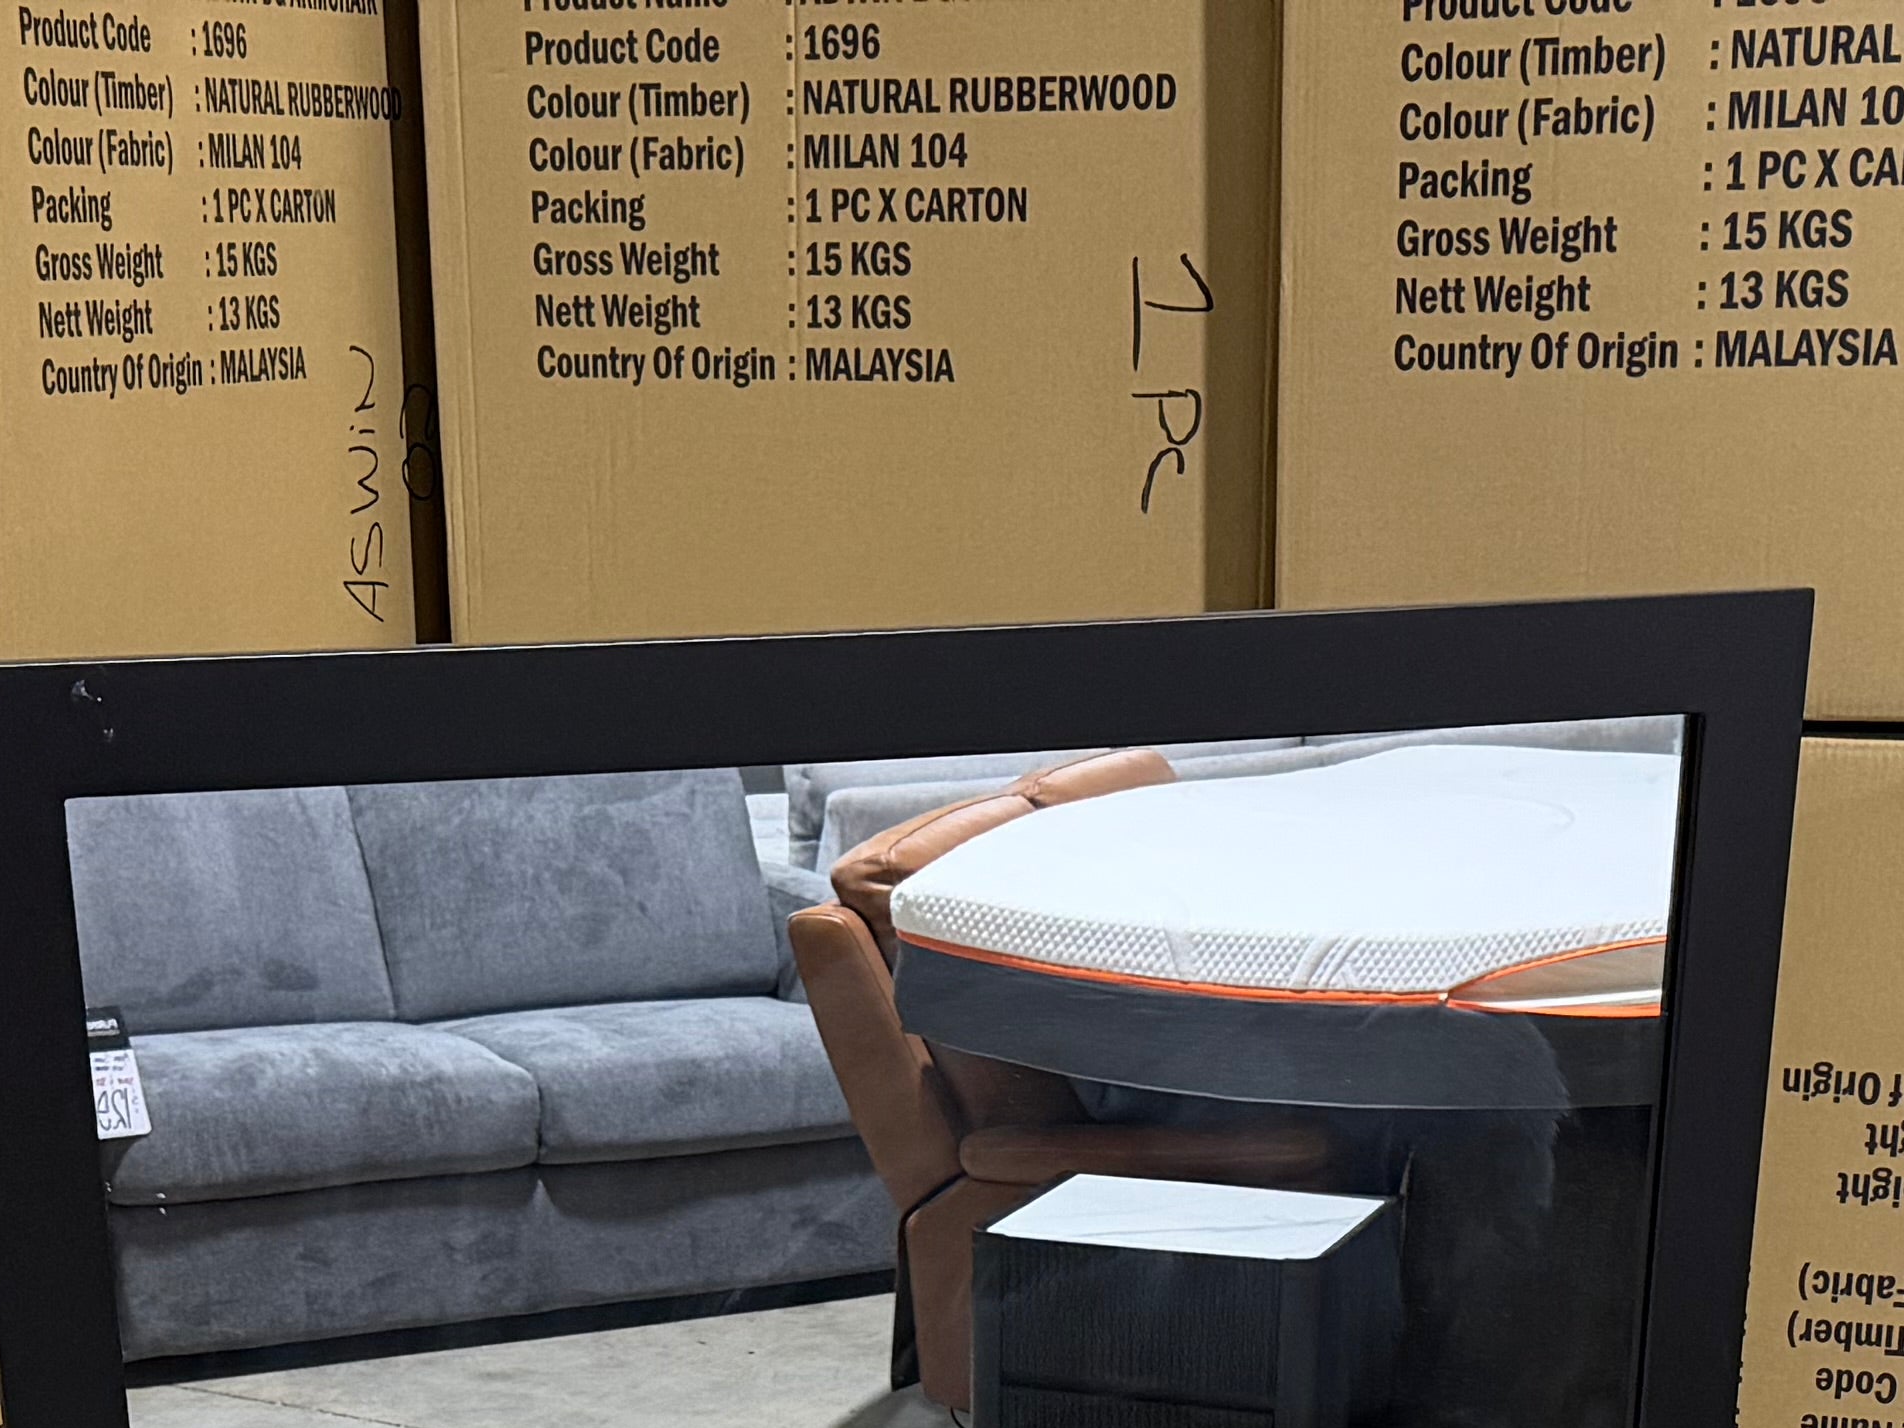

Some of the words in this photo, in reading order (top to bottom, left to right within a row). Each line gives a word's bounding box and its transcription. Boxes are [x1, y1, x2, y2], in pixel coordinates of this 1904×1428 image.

[18, 5, 100, 50] Product
[102, 11, 152, 53] Code
[525, 29, 639, 66] Product
[645, 27, 720, 64] Code
[1400, 41, 1512, 83] Colour
[1519, 32, 1666, 87] (Timber)
[23, 66, 90, 108] Colour
[94, 70, 174, 120] (Timber)
[527, 84, 622, 120] Colour
[628, 80, 750, 126] (Timber)
[949, 73, 1177, 113] RUBBERWOOD
[1399, 101, 1510, 142] Colour
[1517, 94, 1655, 146] (Fabric)
[27, 126, 94, 166] Colour
[98, 128, 174, 176] (Fabric)
[269, 134, 302, 171] 104
[531, 189, 646, 232] Packing
[831, 187, 871, 223] PC
[877, 187, 898, 223] X
[905, 186, 1027, 223] CARTON
[1397, 219, 1491, 258] Gross
[1498, 215, 1618, 264] Weight
[1778, 208, 1853, 250] KGS
[35, 243, 93, 282] Gross
[94, 242, 165, 288] Weight
[242, 240, 278, 277] KGS
[535, 293, 597, 328] Nett
[600, 293, 701, 336] Weight
[852, 293, 911, 330] KGS
[1395, 277, 1466, 315] Nett
[1473, 274, 1592, 322] Weight
[1774, 268, 1849, 309] KGS
[41, 356, 119, 400] Country
[122, 352, 144, 391] Of
[147, 351, 203, 396] Origin
[537, 344, 646, 387] Country
[652, 344, 685, 380] Of
[691, 345, 776, 389] Origin
[1394, 333, 1523, 379] Country
[1530, 330, 1570, 370] Of
[1577, 330, 1679, 378] Origin
[1782, 1061, 1881, 1106] Origin
[1815, 1367, 1897, 1405] Code
